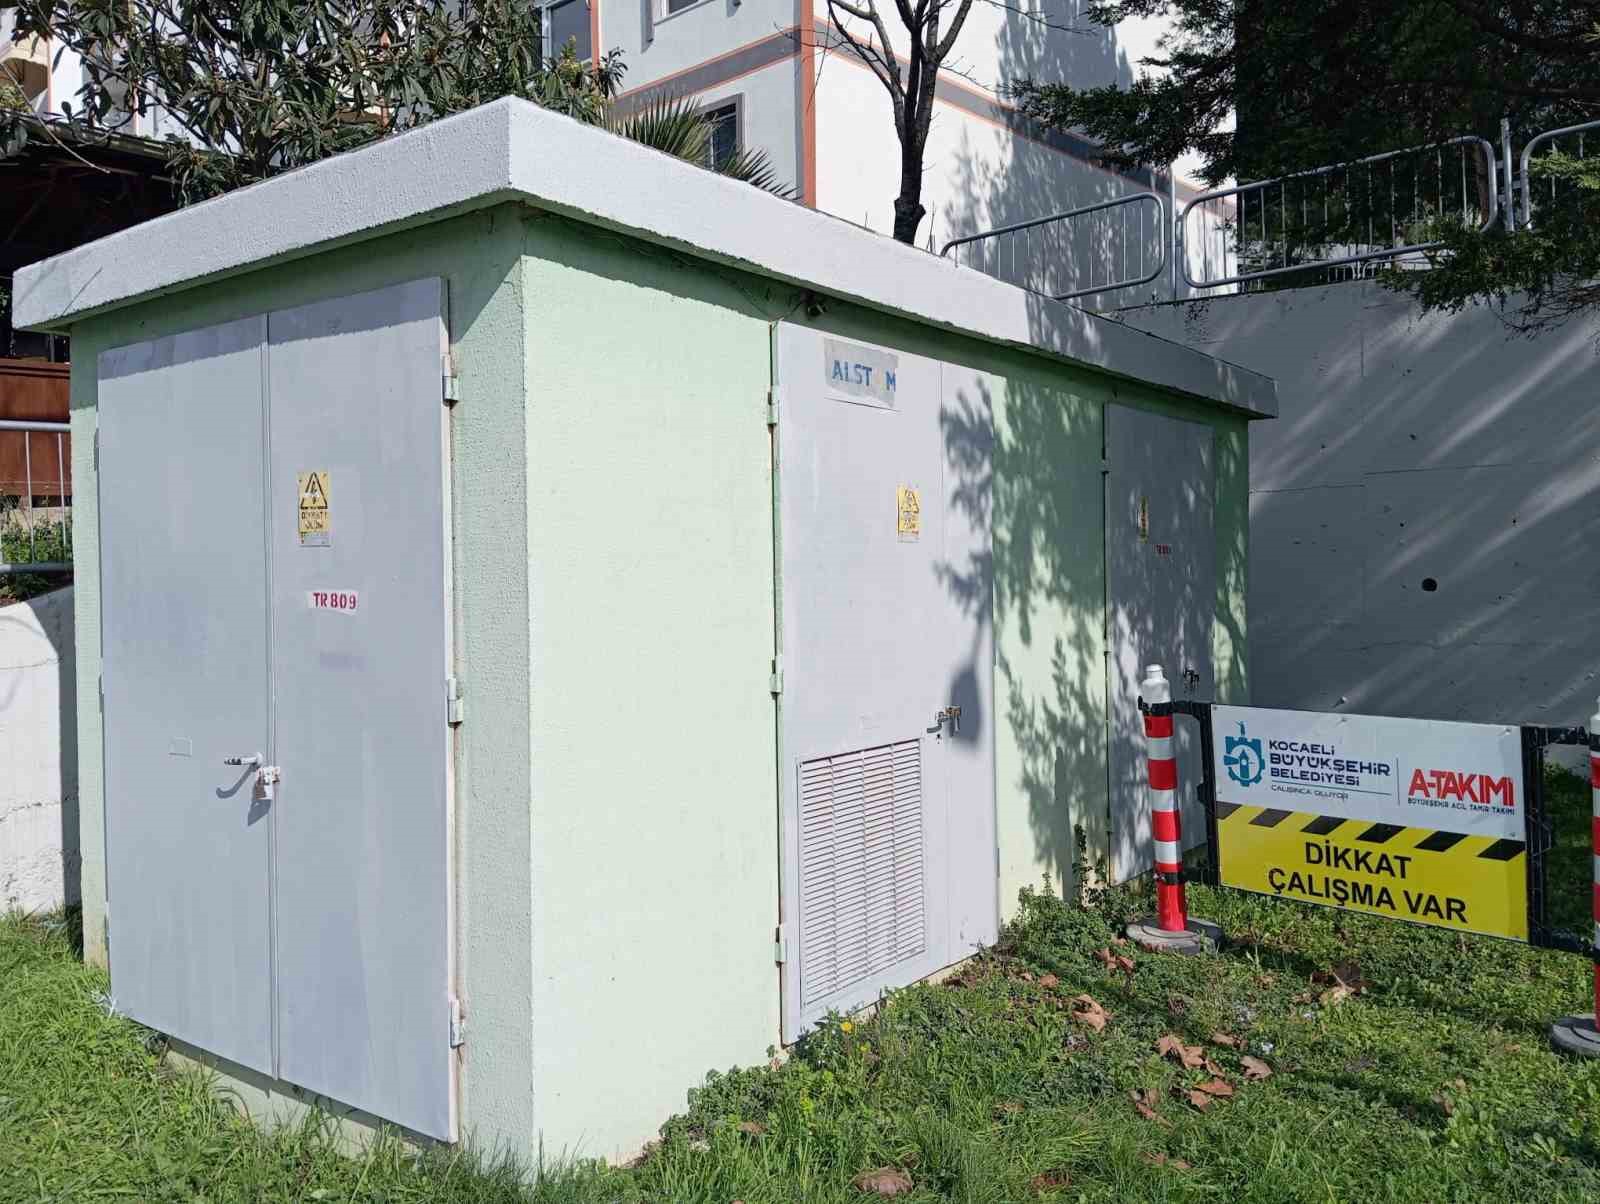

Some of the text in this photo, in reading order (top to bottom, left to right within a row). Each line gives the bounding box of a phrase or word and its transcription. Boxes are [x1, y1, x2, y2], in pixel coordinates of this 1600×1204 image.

[832, 360, 896, 392] ALSTM
[1269, 740, 1335, 756] KOCAELİ
[1270, 753, 1390, 777] BÜYÜKŞEHİR
[1270, 767, 1360, 787] BELEDİYESİ
[1408, 768, 1514, 806] A-TAKIMI
[1305, 840, 1412, 880] DİKKAT
[1268, 868, 1469, 924] ÇALIŞMA VAR
